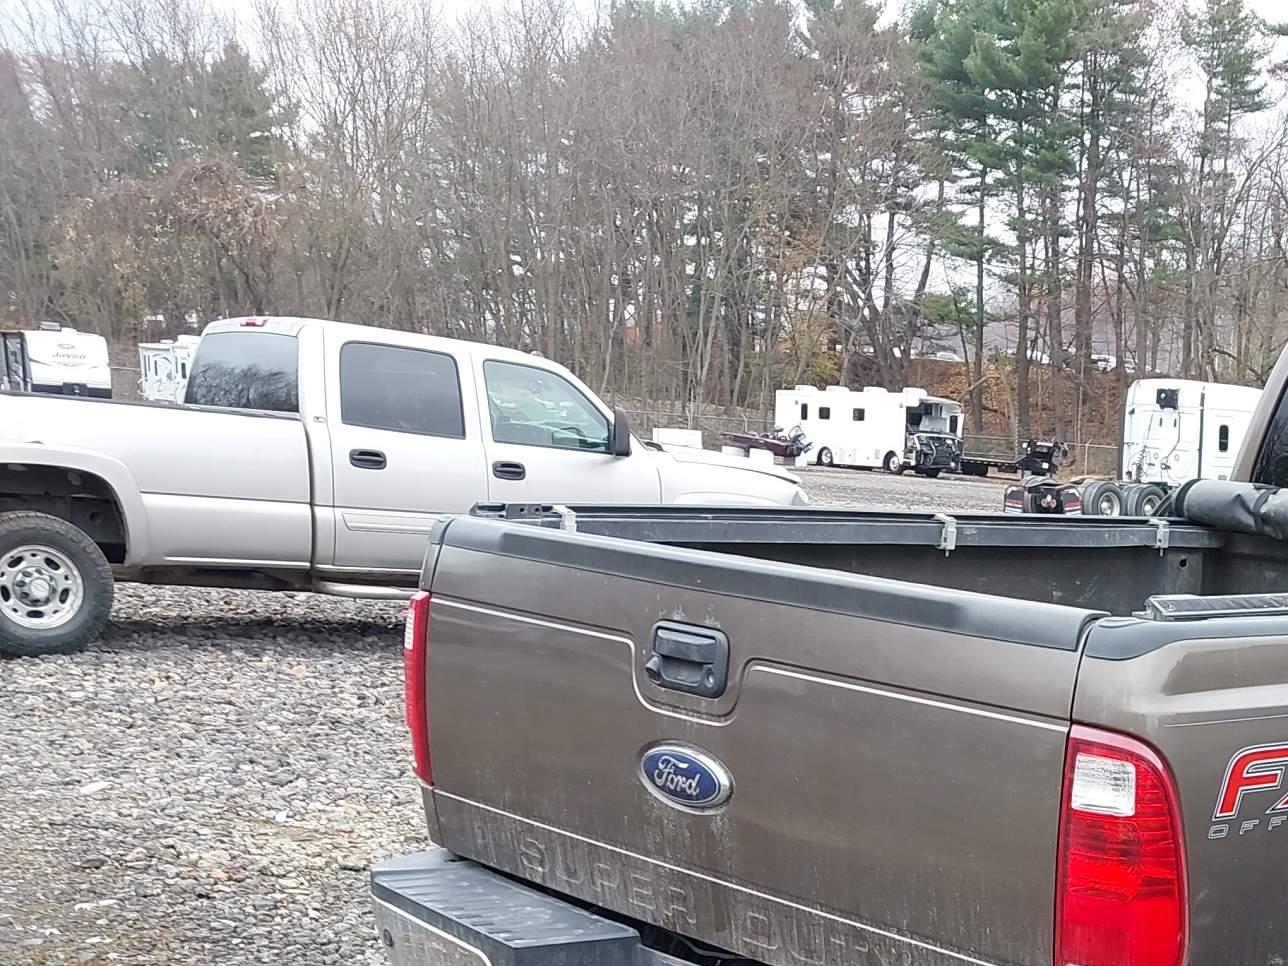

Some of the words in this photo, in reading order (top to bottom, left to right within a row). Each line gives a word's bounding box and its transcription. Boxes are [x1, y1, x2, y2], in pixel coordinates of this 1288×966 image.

[653, 755, 702, 796] Ford
[1207, 814, 1288, 840] OFF
[518, 836, 698, 928] SUPER
